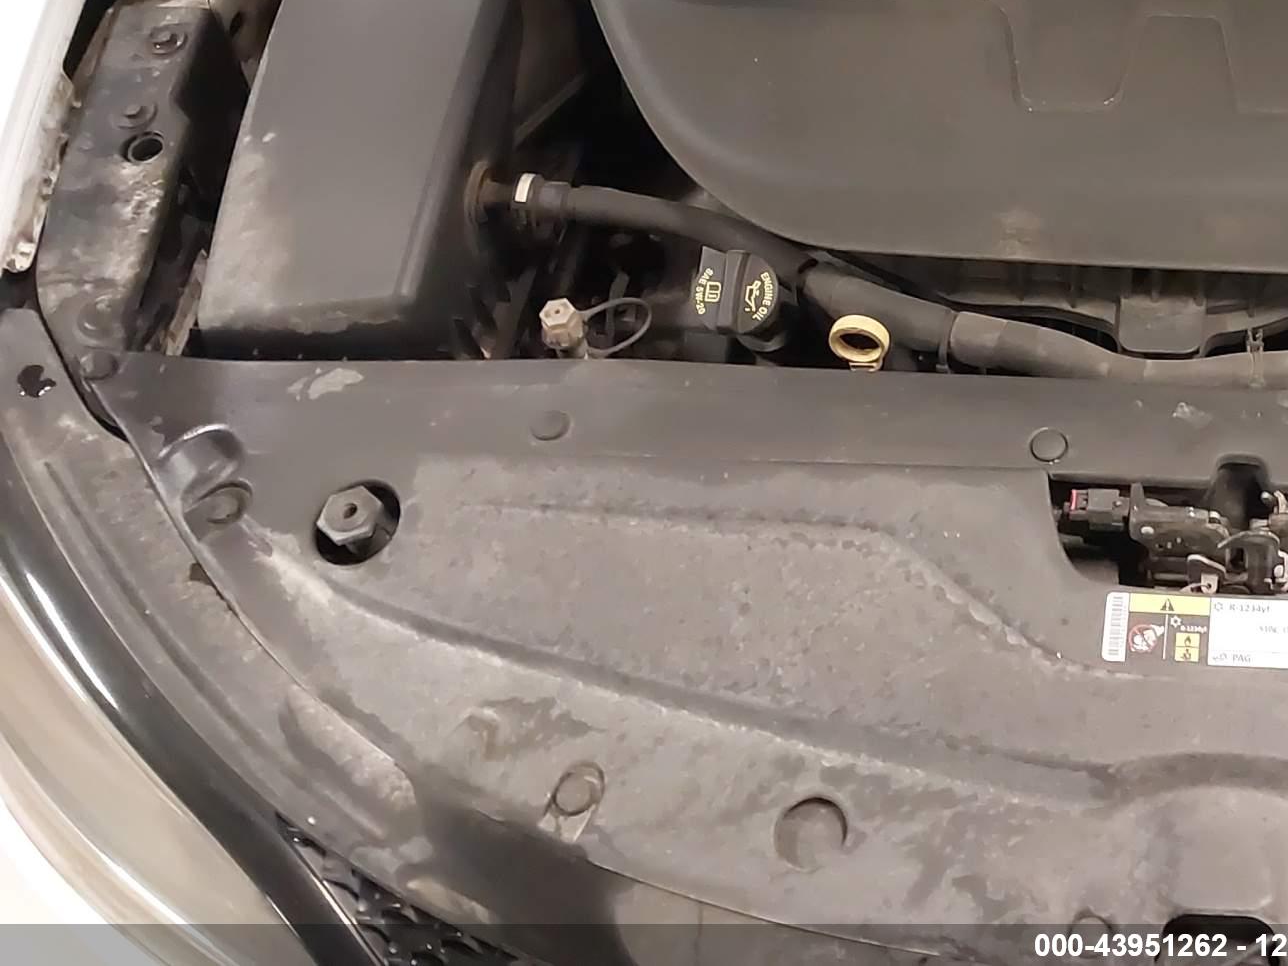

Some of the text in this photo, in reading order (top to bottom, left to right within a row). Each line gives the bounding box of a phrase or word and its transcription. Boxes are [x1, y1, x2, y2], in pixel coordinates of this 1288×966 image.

[694, 267, 714, 315] SAE 5W-20
[752, 271, 775, 322] ENGINE OIL
